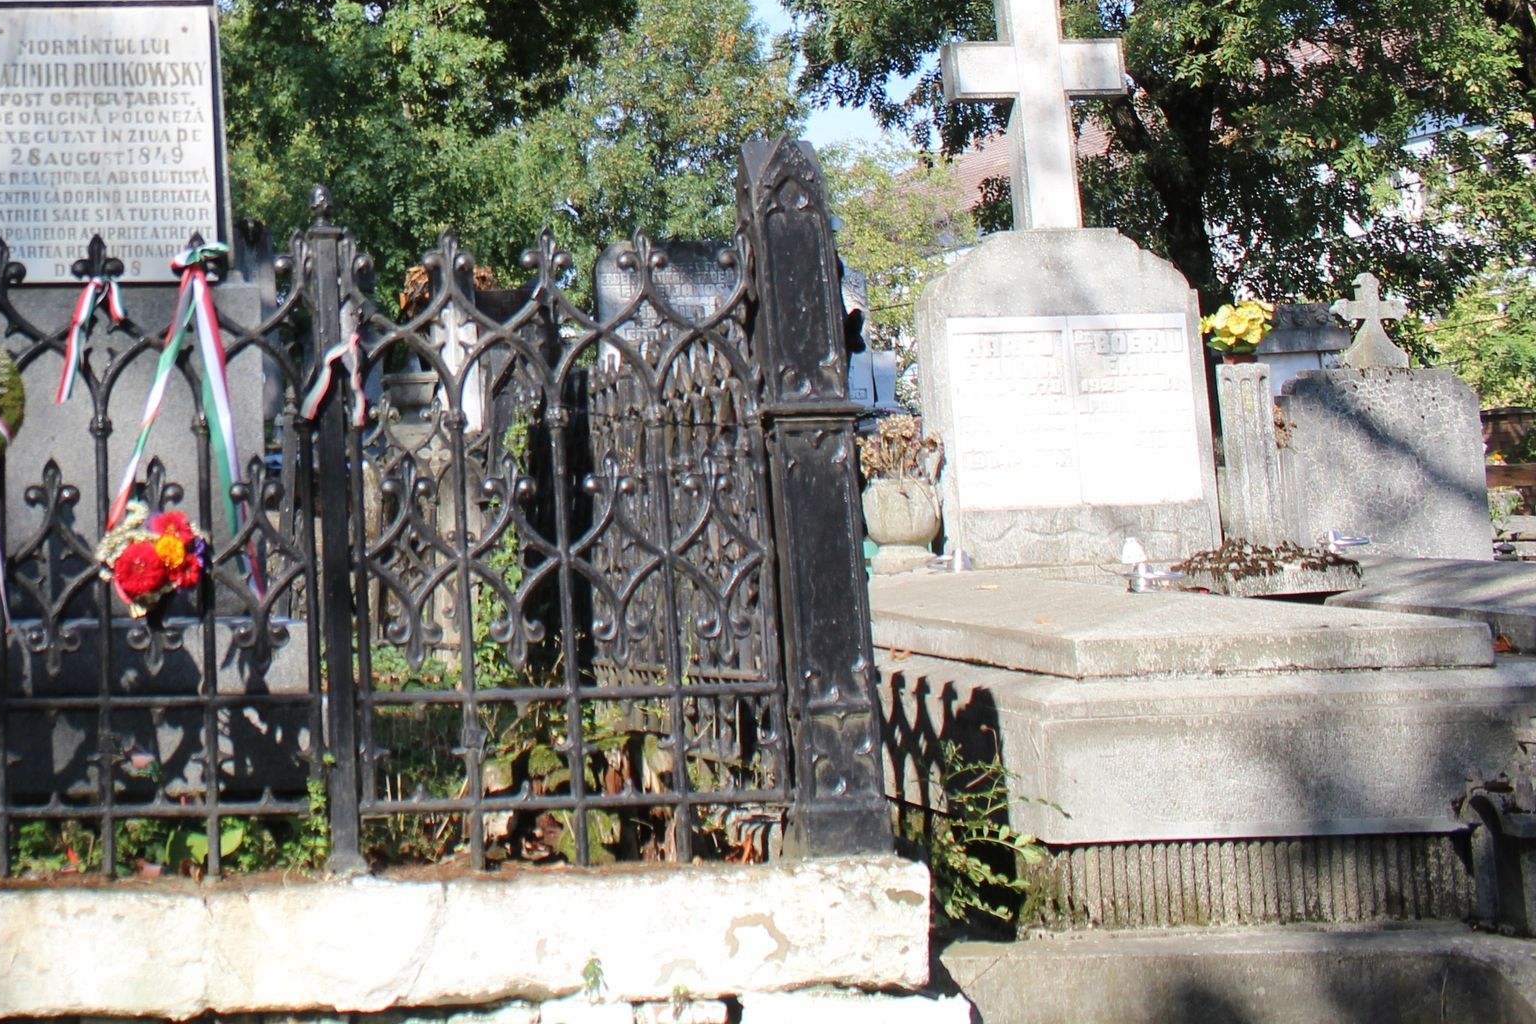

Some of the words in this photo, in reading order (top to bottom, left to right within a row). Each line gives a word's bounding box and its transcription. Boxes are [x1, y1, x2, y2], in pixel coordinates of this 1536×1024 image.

[140, 38, 170, 55] LUI
[73, 62, 207, 88] RULIKOWSKY
[0, 93, 44, 107] FOST
[127, 129, 172, 143] ZIUA
[177, 128, 203, 143] DE
[43, 150, 125, 166] AUGUST
[125, 190, 212, 204] LIBERTATEA
[52, 208, 90, 222] SALE
[127, 207, 210, 222] TUTUROR
